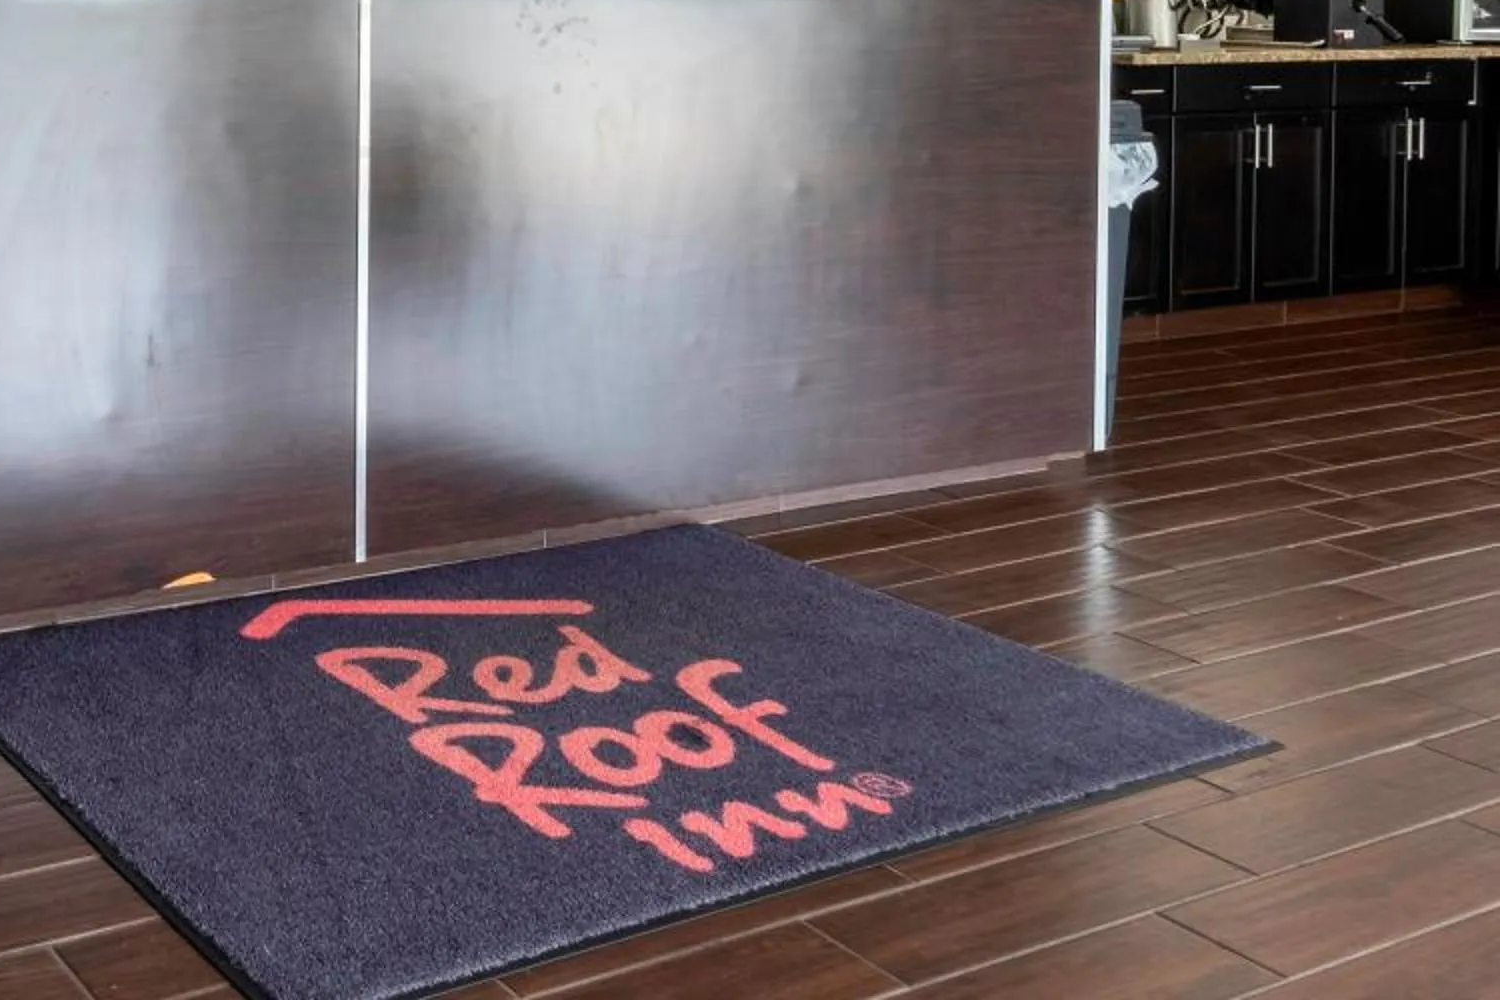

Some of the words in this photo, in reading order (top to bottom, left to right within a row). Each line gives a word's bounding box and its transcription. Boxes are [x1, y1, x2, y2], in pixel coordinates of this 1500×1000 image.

[316, 626, 650, 723] Red
[411, 659, 833, 838] Roof
[622, 774, 893, 873] Inn
